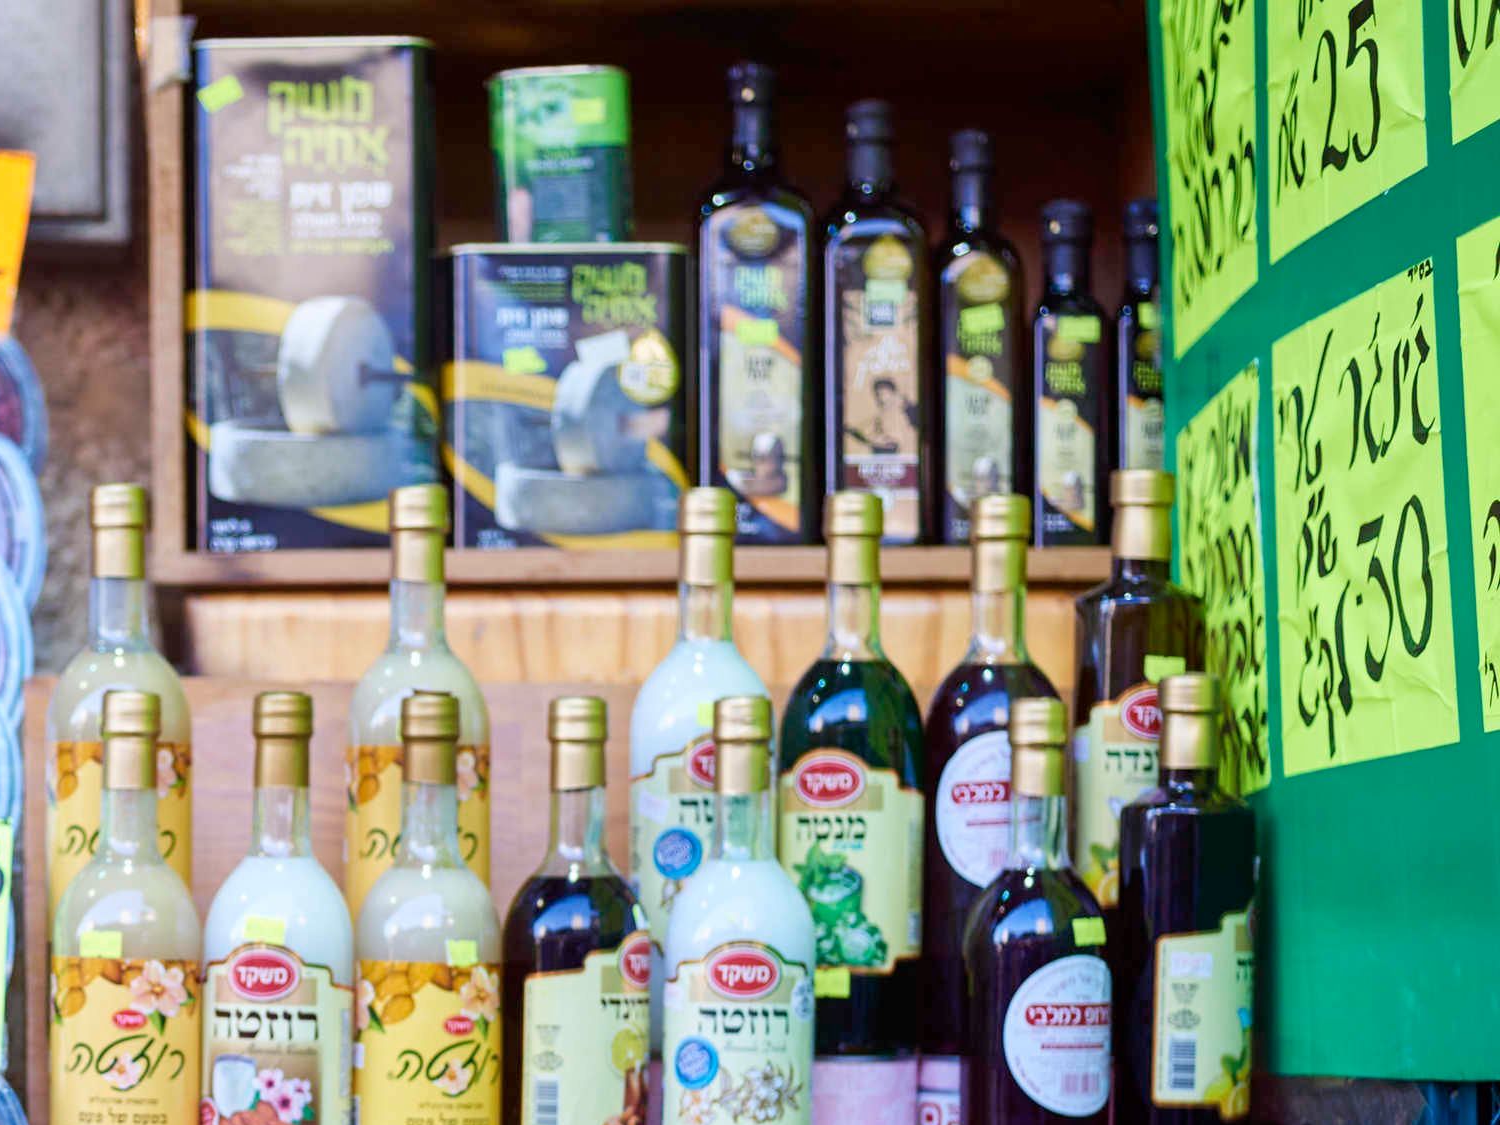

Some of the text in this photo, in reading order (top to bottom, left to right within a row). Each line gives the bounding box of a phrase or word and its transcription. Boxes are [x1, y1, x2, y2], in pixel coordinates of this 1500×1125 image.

[1313, 0, 1380, 177] 25
[213, 1009, 320, 1041] רוזטה
[698, 1008, 789, 1035] רוזטה
